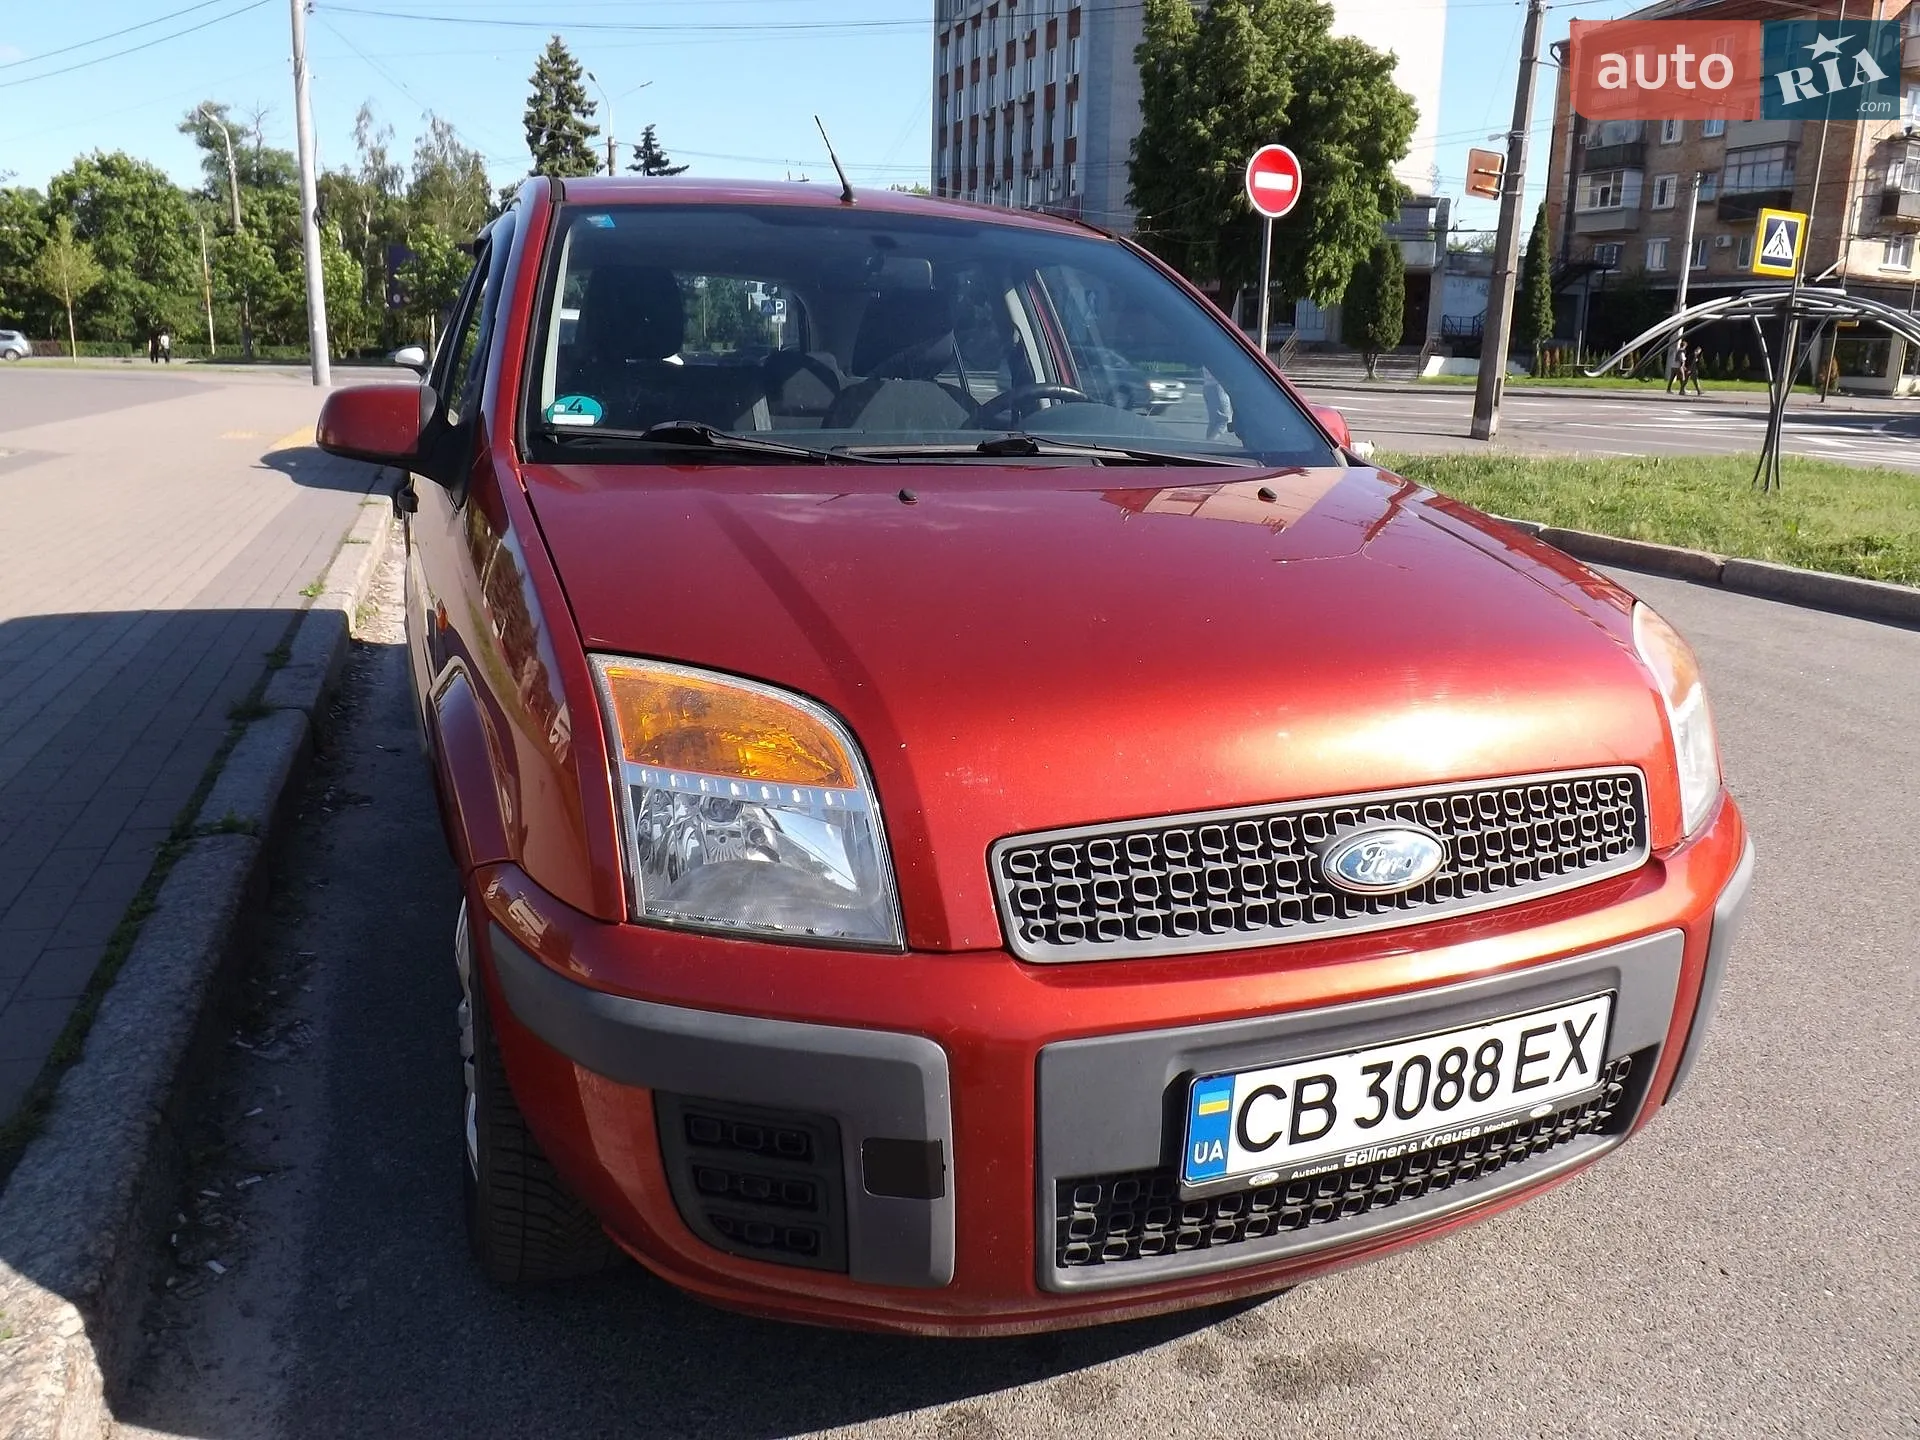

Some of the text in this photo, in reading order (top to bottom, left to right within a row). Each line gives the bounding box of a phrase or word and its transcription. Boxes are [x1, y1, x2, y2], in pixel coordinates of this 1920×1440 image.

[567, 398, 584, 414] 4
[1236, 1012, 1597, 1152] CB 3088 EX
[1194, 1139, 1224, 1164] UA
[1291, 1163, 1339, 1180] Autohaus
[1343, 1143, 1407, 1168] Söllner
[1408, 1142, 1418, 1153] &
[1421, 1126, 1480, 1150] Krause
